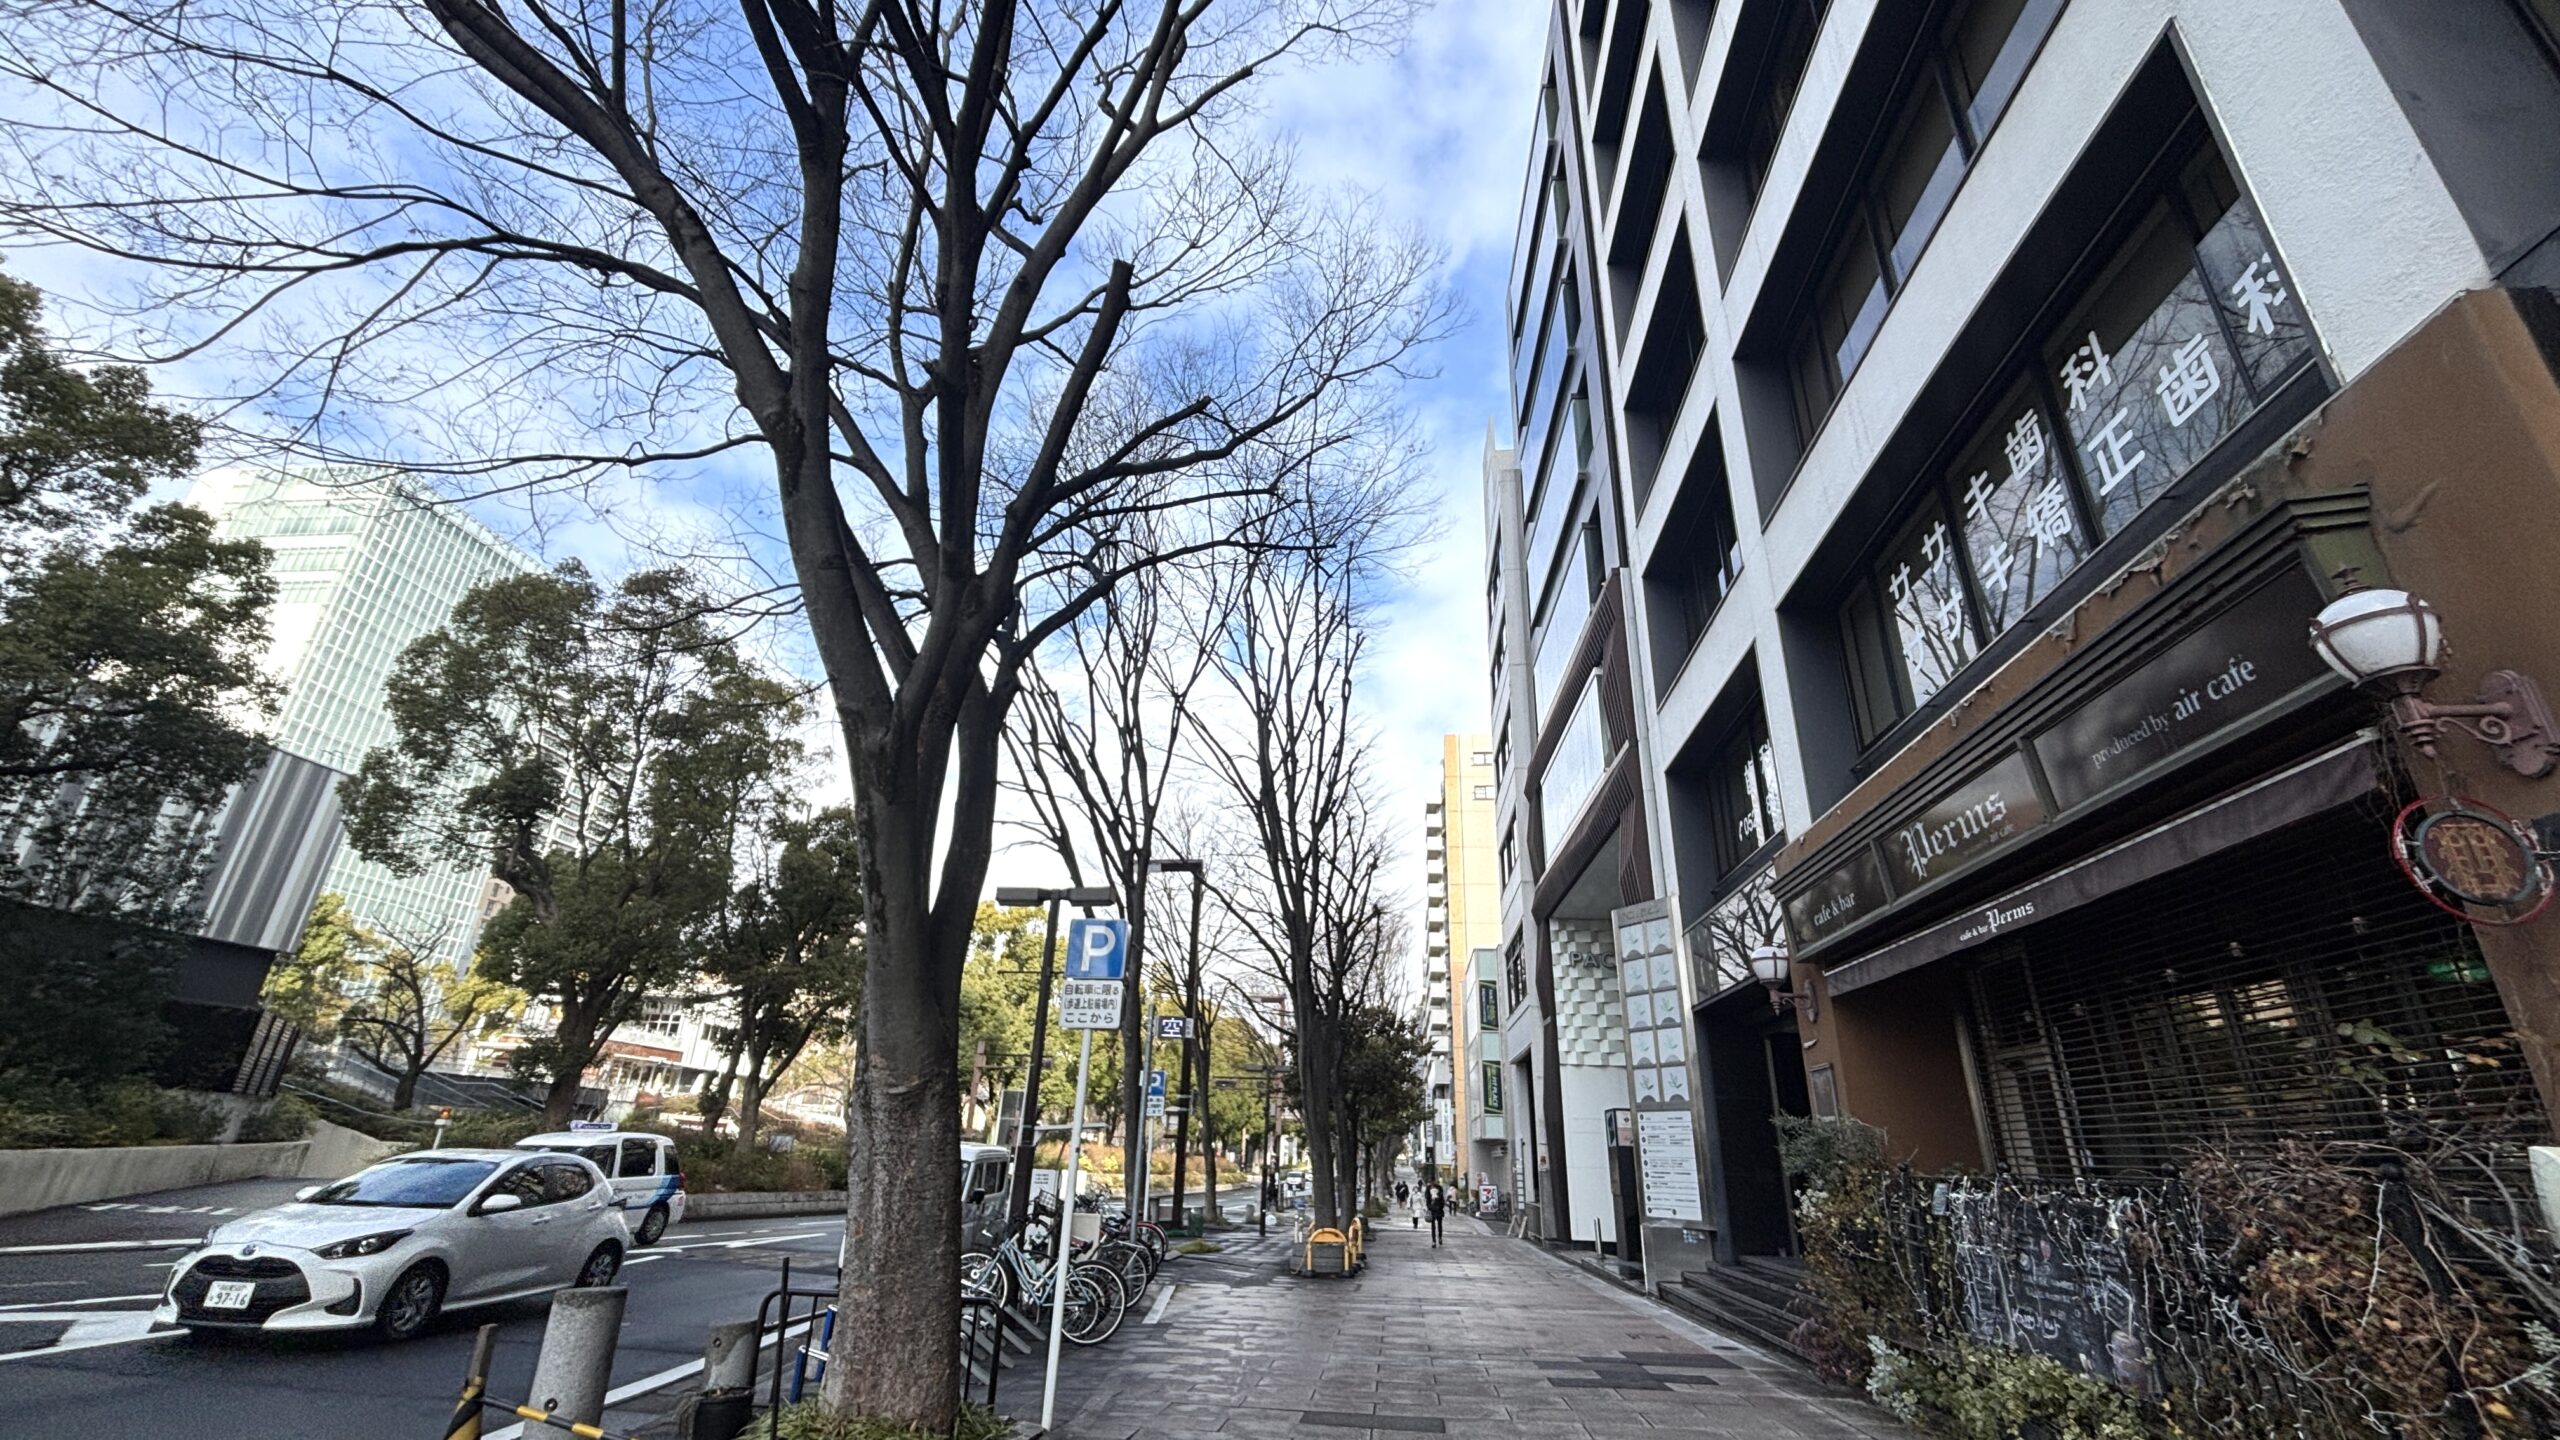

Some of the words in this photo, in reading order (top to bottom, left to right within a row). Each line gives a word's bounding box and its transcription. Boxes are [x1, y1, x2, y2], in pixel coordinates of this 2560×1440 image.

[1889, 331, 2110, 610] ササキ歯科
[2091, 721, 2151, 769] produced
[2150, 711, 2170, 732] by
[2172, 688, 2201, 721] air
[1900, 791, 2008, 881] Perms
[1814, 899, 1831, 926] cafe
[1840, 891, 1857, 912] bar
[1986, 902, 2035, 933] Perms
[1080, 925, 1117, 972] P
[1064, 983, 1120, 996] 自転車に限る
[1064, 1012, 1114, 1024] ここから
[1161, 1018, 1183, 1037] 空
[215, 1292, 247, 1305] 97-16
